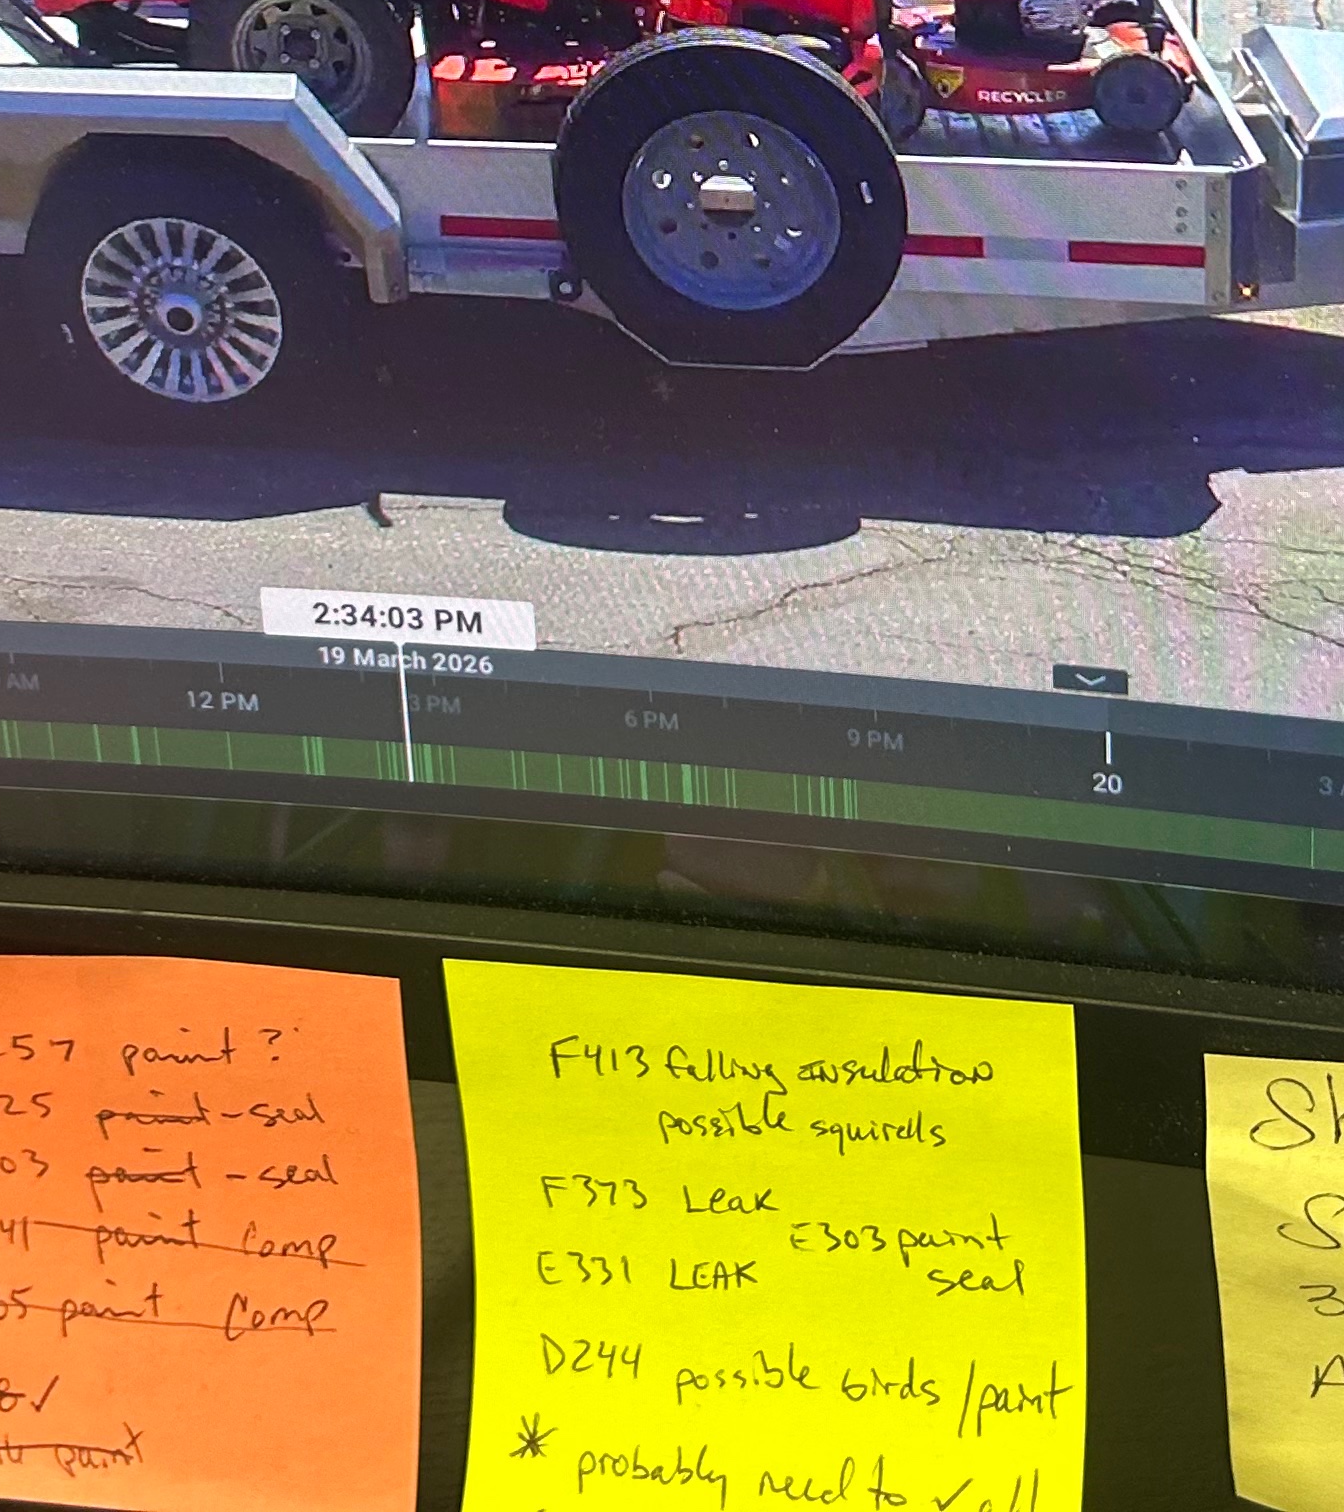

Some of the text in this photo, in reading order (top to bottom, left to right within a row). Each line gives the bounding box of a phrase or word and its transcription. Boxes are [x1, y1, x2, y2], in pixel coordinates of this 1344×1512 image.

[312, 600, 484, 635] 2:34:03 PM
[318, 645, 494, 675] 19 March 2026
[6, 672, 40, 691] AM
[187, 690, 260, 712] 12 PM
[426, 696, 462, 715] PM
[624, 709, 679, 732] 6 PM
[846, 728, 904, 753] 9 PM
[1092, 773, 1123, 795] 20
[1318, 775, 1332, 795] 3
[549, 1035, 650, 1081] F413
[657, 1091, 793, 1144] possible
[540, 1175, 649, 1211] F373
[790, 1221, 887, 1254] E303
[537, 1250, 632, 1286] E331
[540, 1333, 643, 1380] D244
[675, 1341, 821, 1405] possible
[576, 1443, 728, 1510] probably
